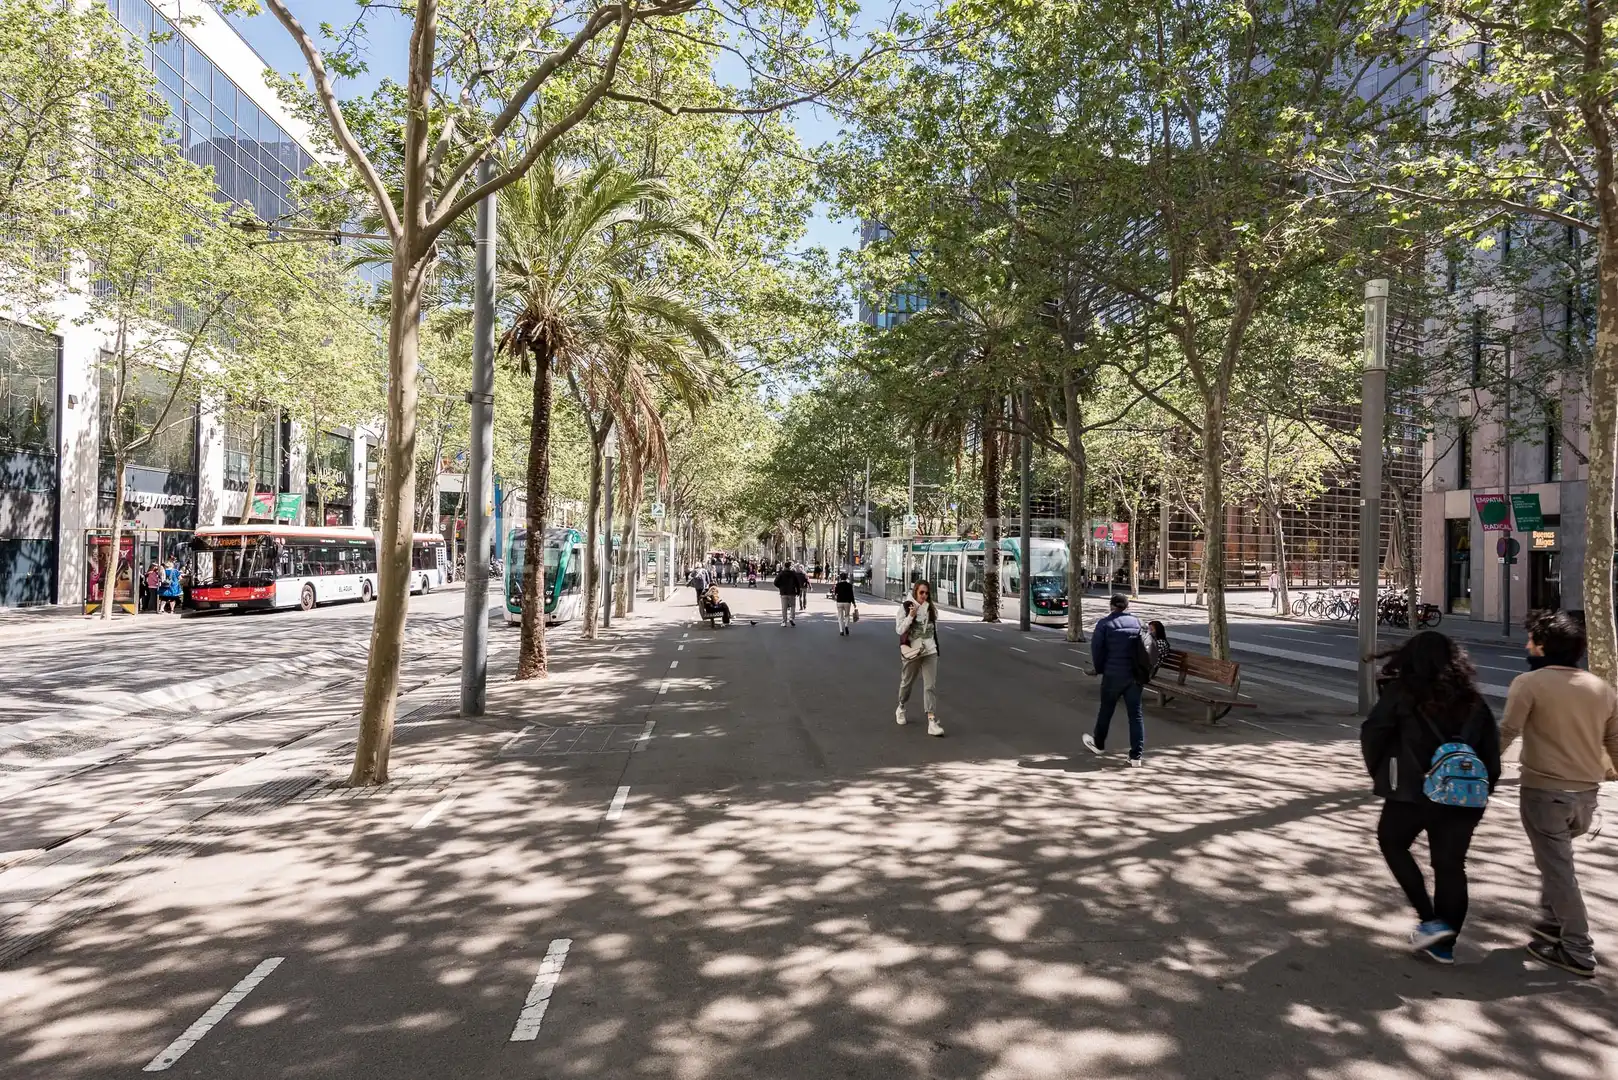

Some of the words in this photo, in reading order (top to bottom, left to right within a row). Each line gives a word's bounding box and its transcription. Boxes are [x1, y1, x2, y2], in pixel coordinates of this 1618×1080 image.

[1475, 496, 1503, 504] EMPATIA
[1532, 530, 1555, 539] Buenas
[1535, 537, 1555, 547] Migas
